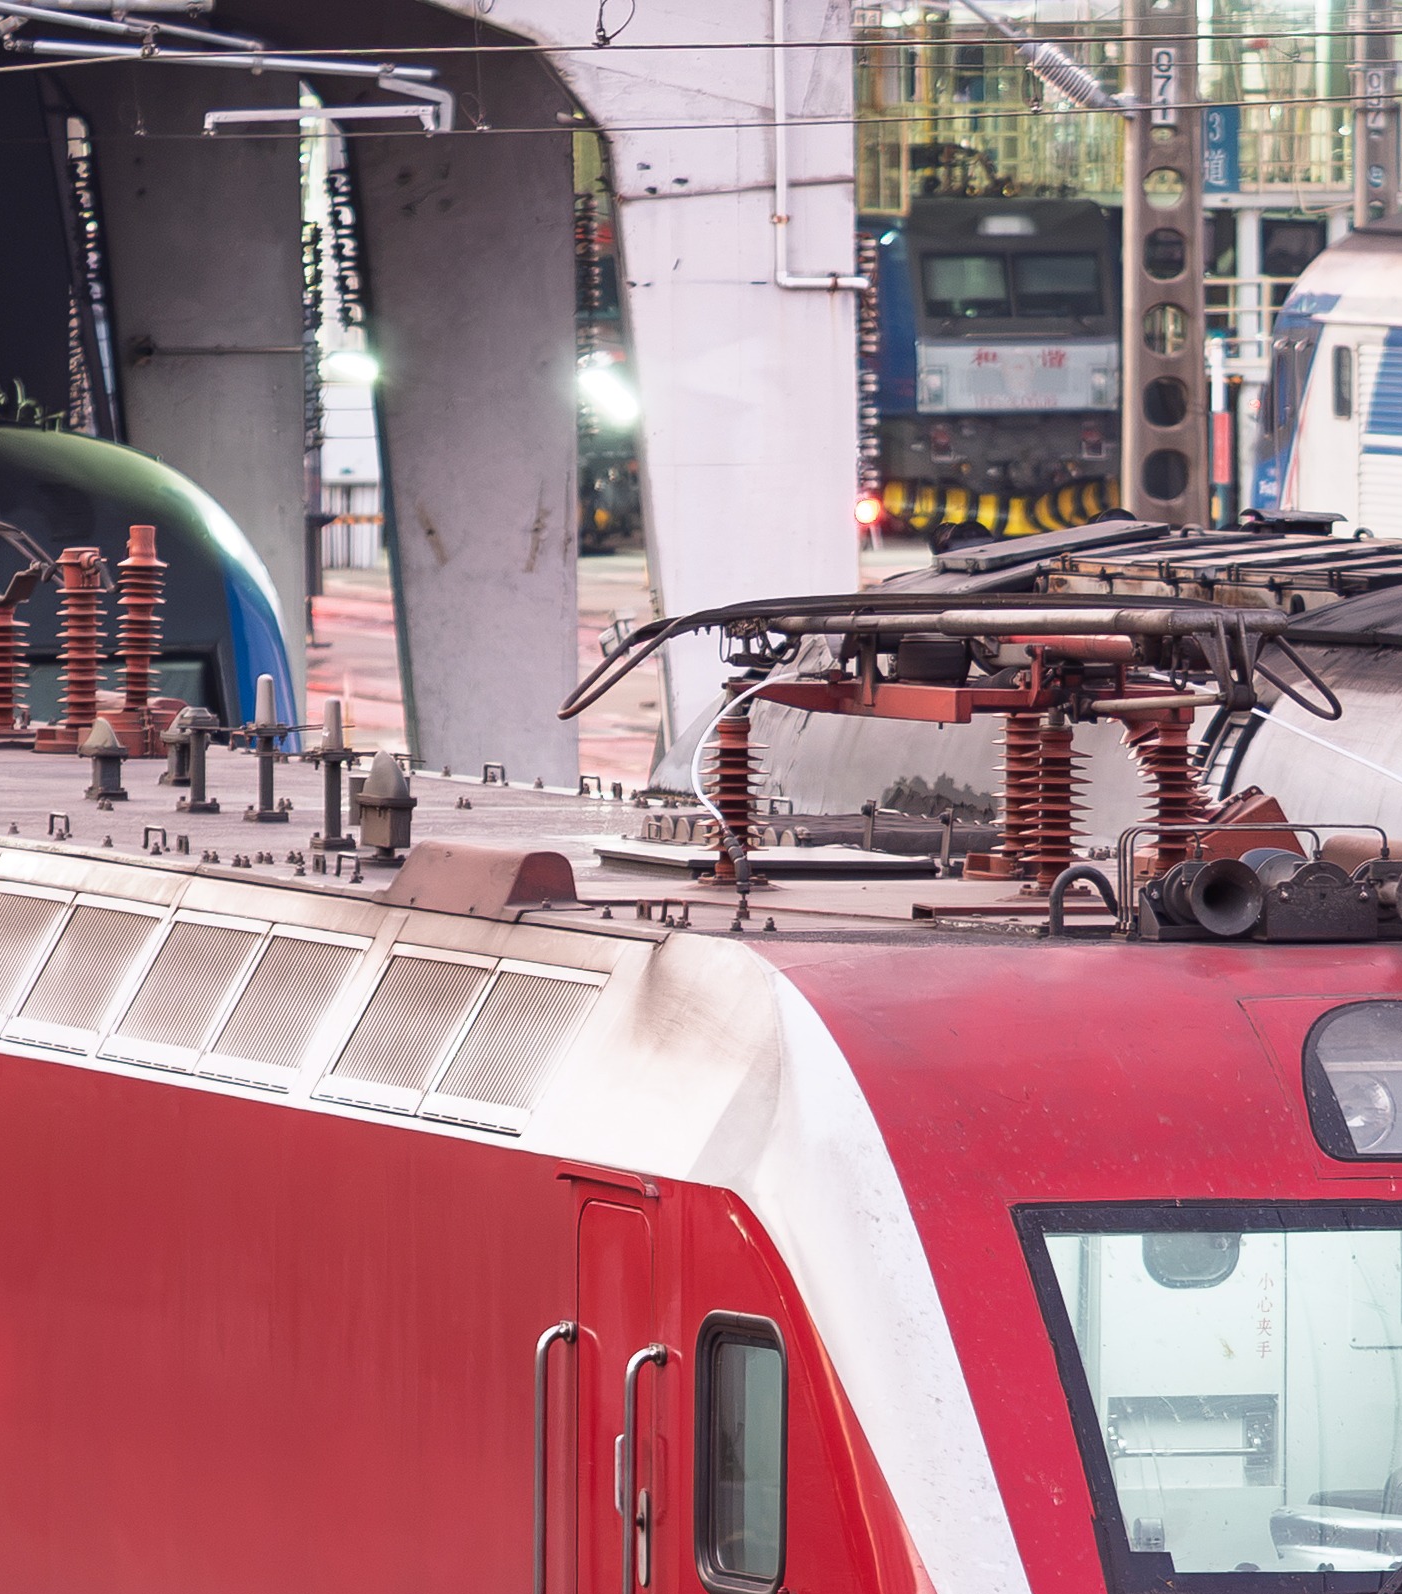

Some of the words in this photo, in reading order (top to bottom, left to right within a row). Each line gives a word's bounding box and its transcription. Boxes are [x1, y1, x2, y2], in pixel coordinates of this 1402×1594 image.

[1154, 50, 1173, 120] 071
[1256, 1272, 1275, 1359] 小心夹手
